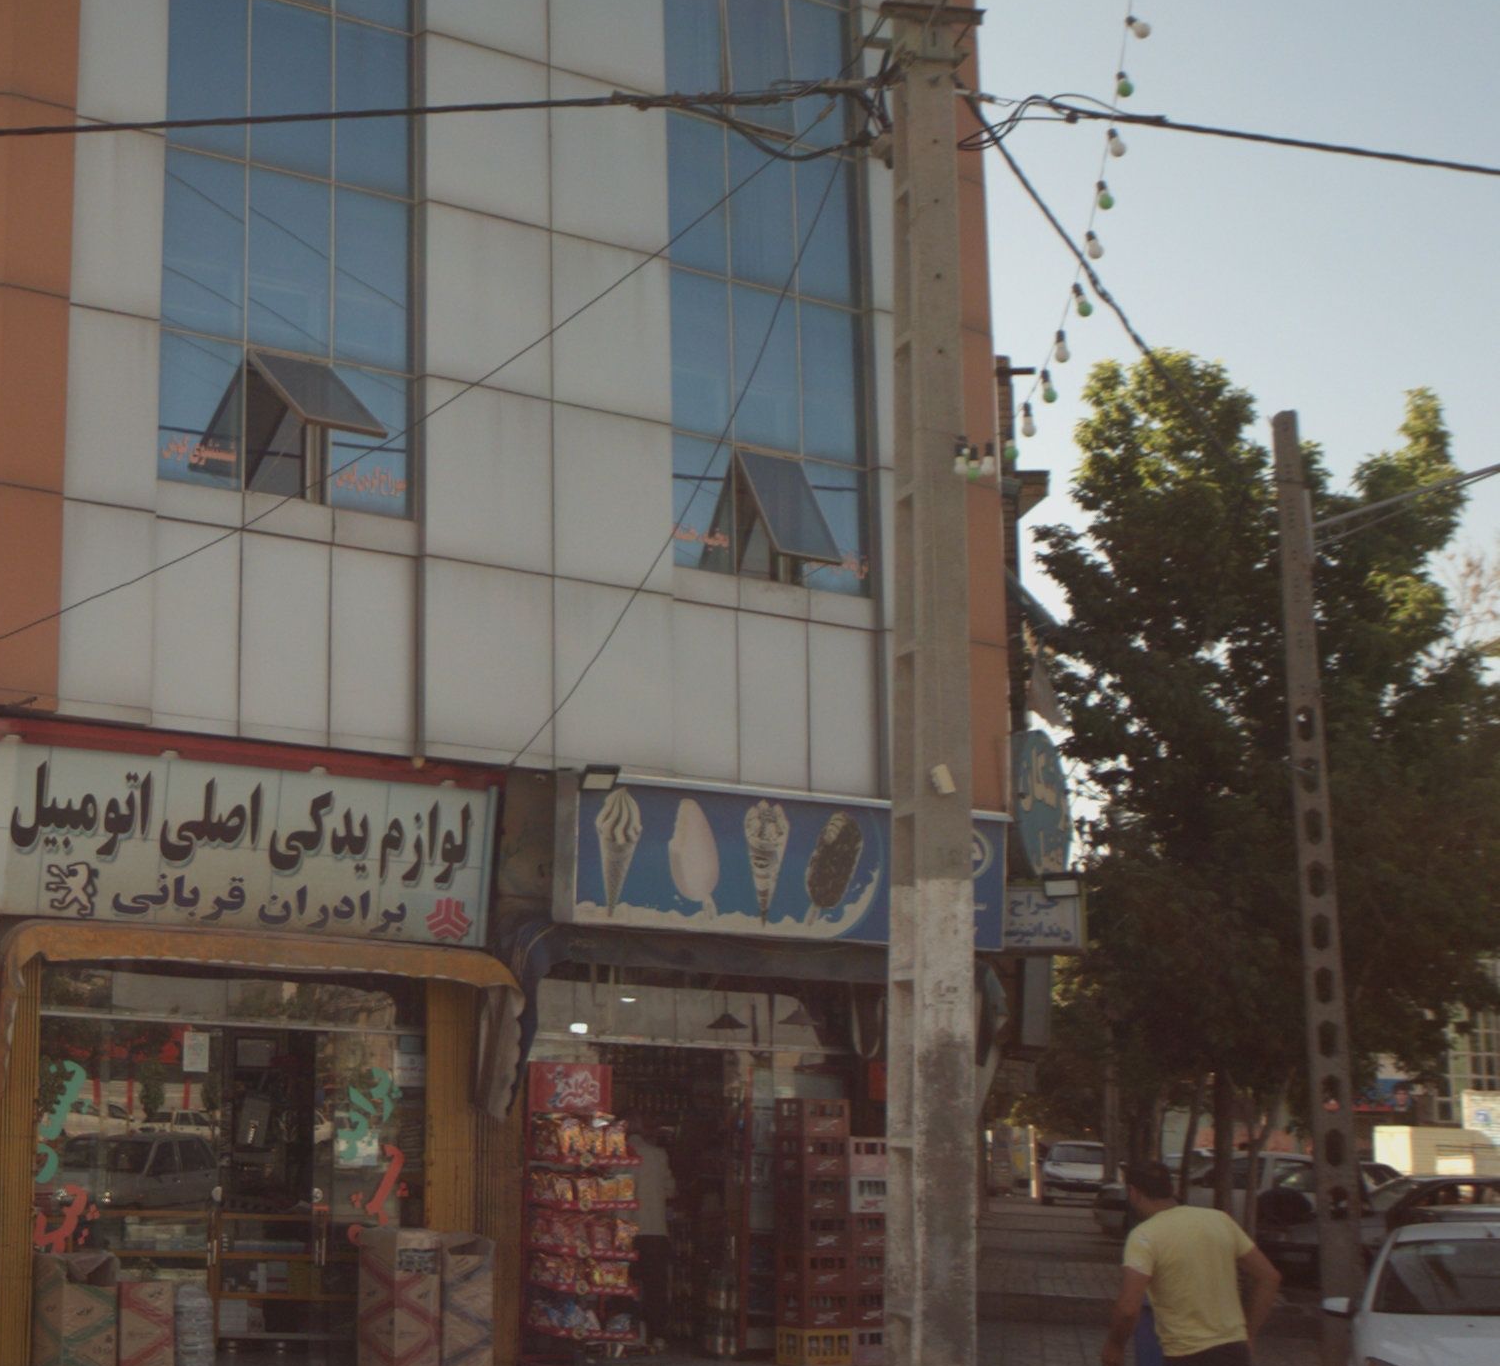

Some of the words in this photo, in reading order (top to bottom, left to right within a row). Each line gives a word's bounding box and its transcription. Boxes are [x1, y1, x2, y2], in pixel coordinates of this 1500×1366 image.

[9, 760, 155, 856] اتومبیل
[159, 776, 265, 863] اصلی
[268, 790, 370, 877] یدکی
[378, 799, 474, 885] لوازم
[111, 872, 247, 925] قربانی
[257, 883, 408, 934] برادران
